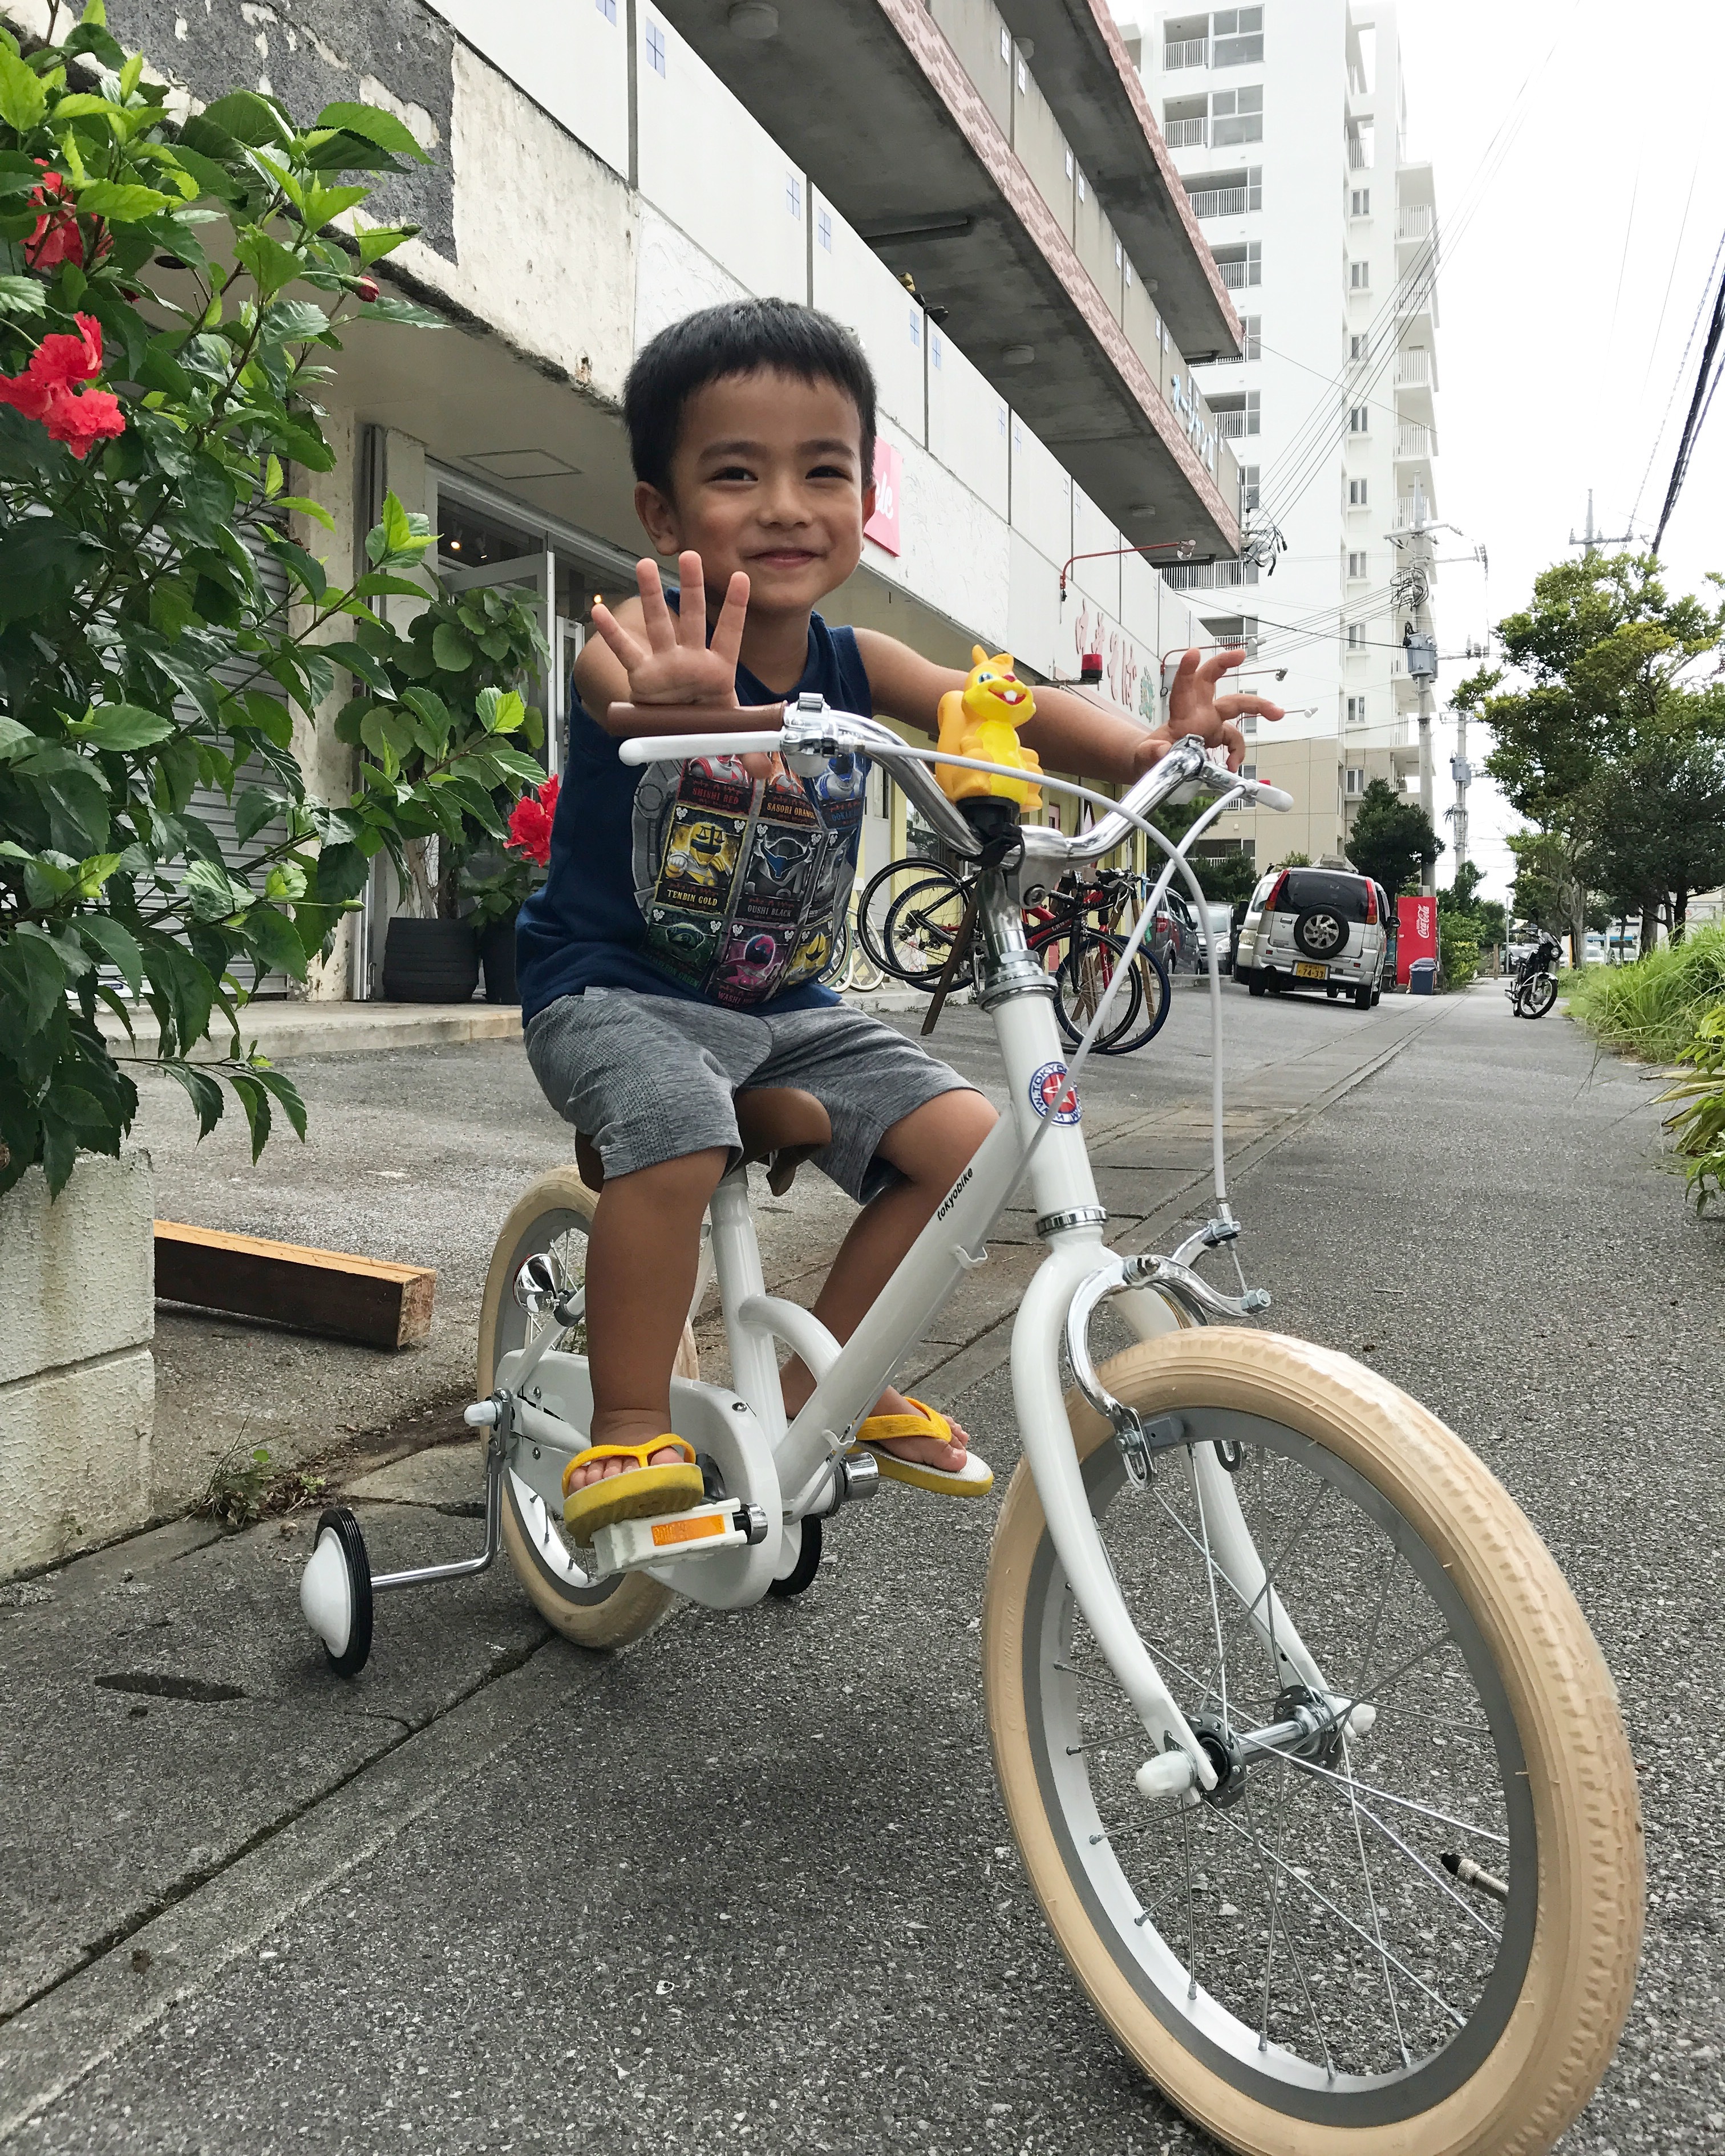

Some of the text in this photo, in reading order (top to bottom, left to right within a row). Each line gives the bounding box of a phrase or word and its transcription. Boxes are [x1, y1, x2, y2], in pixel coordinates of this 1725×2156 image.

[723, 795, 739, 805] RED
[767, 802, 792, 815] SASOBI
[667, 889, 696, 902] TENBIN
[698, 896, 718, 906] GOLD
[747, 905, 792, 917] OUSHI BLACK
[1417, 903, 1430, 939] Coca-Cola
[937, 1168, 973, 1221] tokyobike
